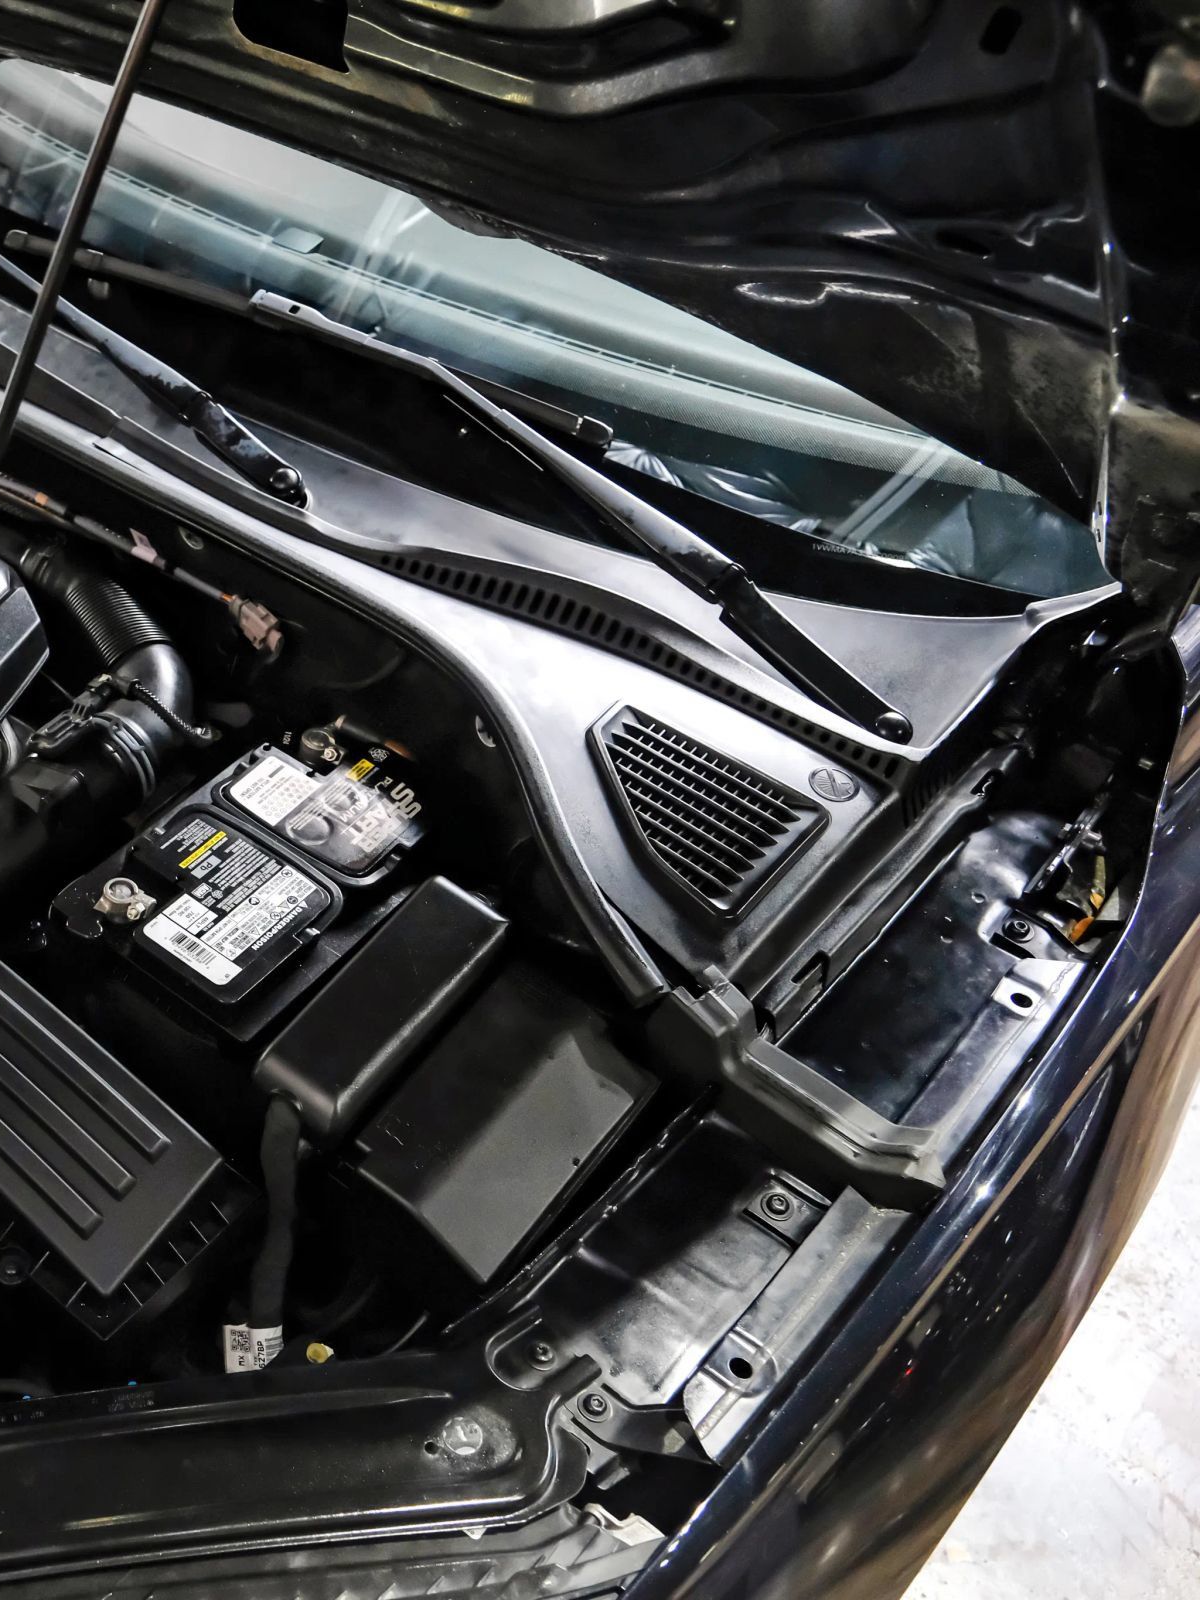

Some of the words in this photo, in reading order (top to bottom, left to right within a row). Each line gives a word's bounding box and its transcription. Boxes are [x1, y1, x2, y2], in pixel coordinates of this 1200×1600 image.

[345, 781, 414, 846] START
[355, 797, 422, 853] SUPER
[200, 861, 212, 871] Pb
[251, 905, 302, 951] DANGER/POISON
[239, 1355, 244, 1366] MX
